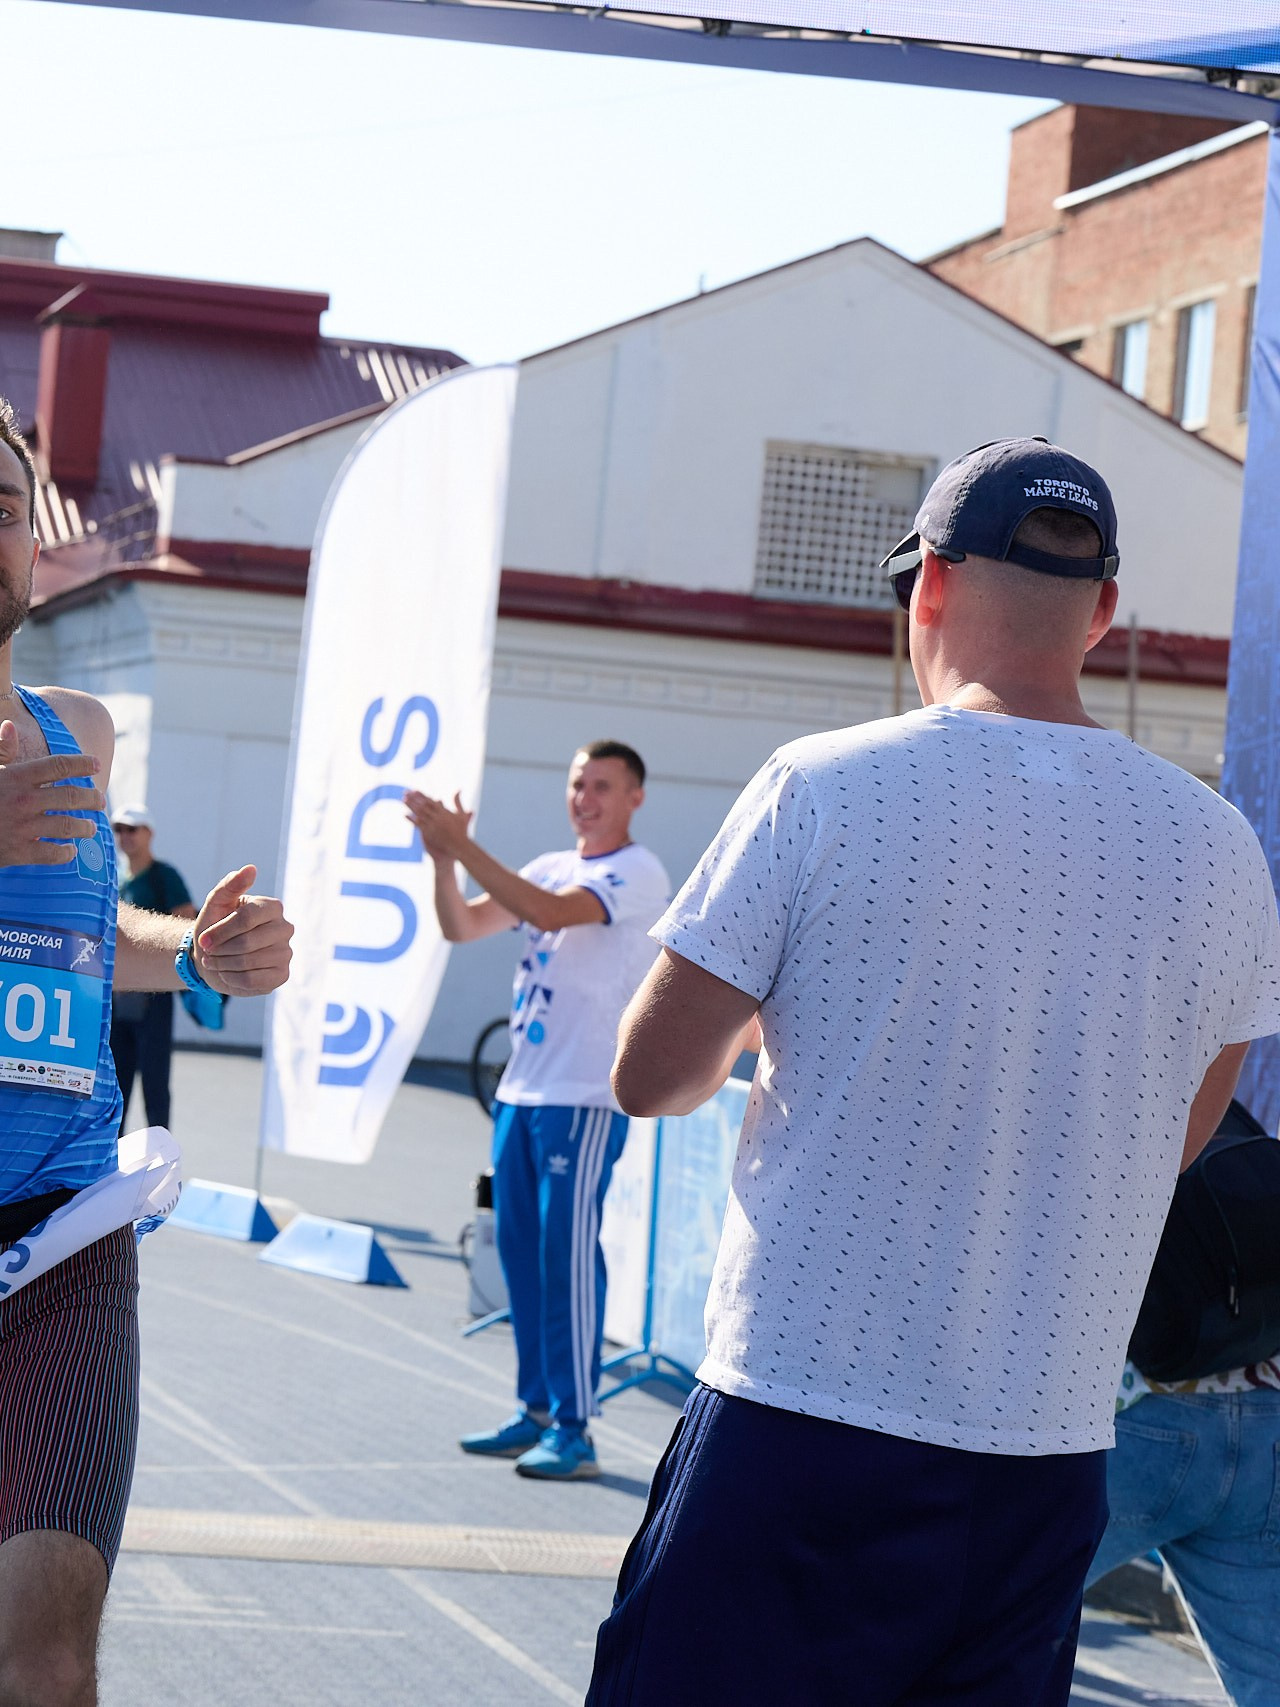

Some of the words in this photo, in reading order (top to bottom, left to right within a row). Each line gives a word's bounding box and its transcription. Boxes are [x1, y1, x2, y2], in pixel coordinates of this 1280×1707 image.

[1024, 487, 1065, 499] MAPLE
[1068, 490, 1099, 511] LEAFS
[1034, 479, 1089, 496] TORONTO
[333, 694, 440, 964] UDS
